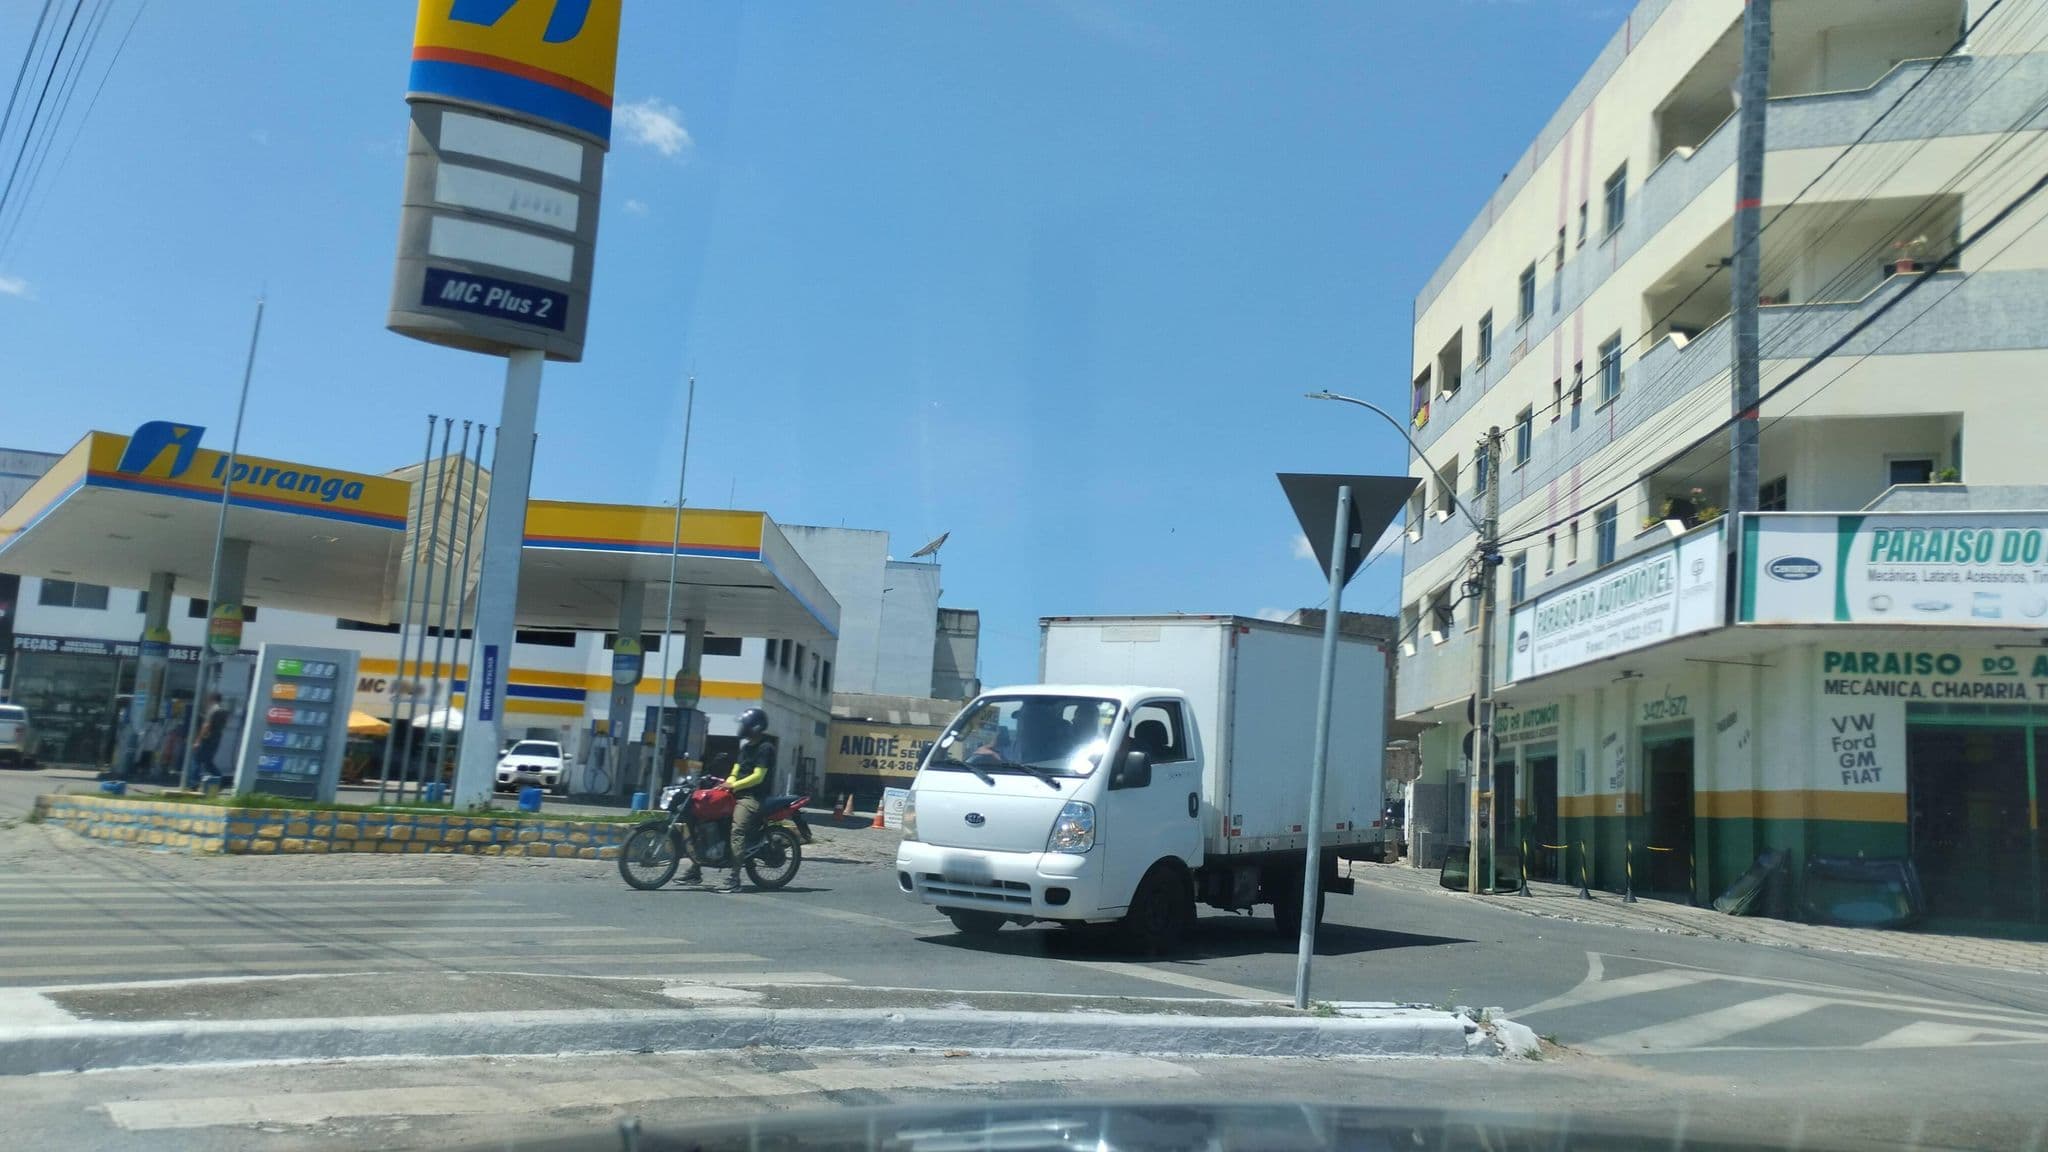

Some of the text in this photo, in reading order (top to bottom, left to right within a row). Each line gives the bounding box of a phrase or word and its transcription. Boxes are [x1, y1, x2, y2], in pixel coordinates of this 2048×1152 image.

[440, 279, 553, 318] MC Plus 2
[211, 455, 365, 502] Ipiranga
[1870, 529, 2042, 564] PARAISO DO
[14, 637, 58, 652] PEÇAS
[1823, 651, 1962, 676] PARAISO
[1982, 656, 2016, 673] DO
[1831, 713, 1875, 734] VW
[839, 735, 898, 757] ANDRÉ
[1831, 733, 1876, 752] Ford
[1840, 751, 1876, 769] GM
[1841, 767, 1882, 785] FIAT
